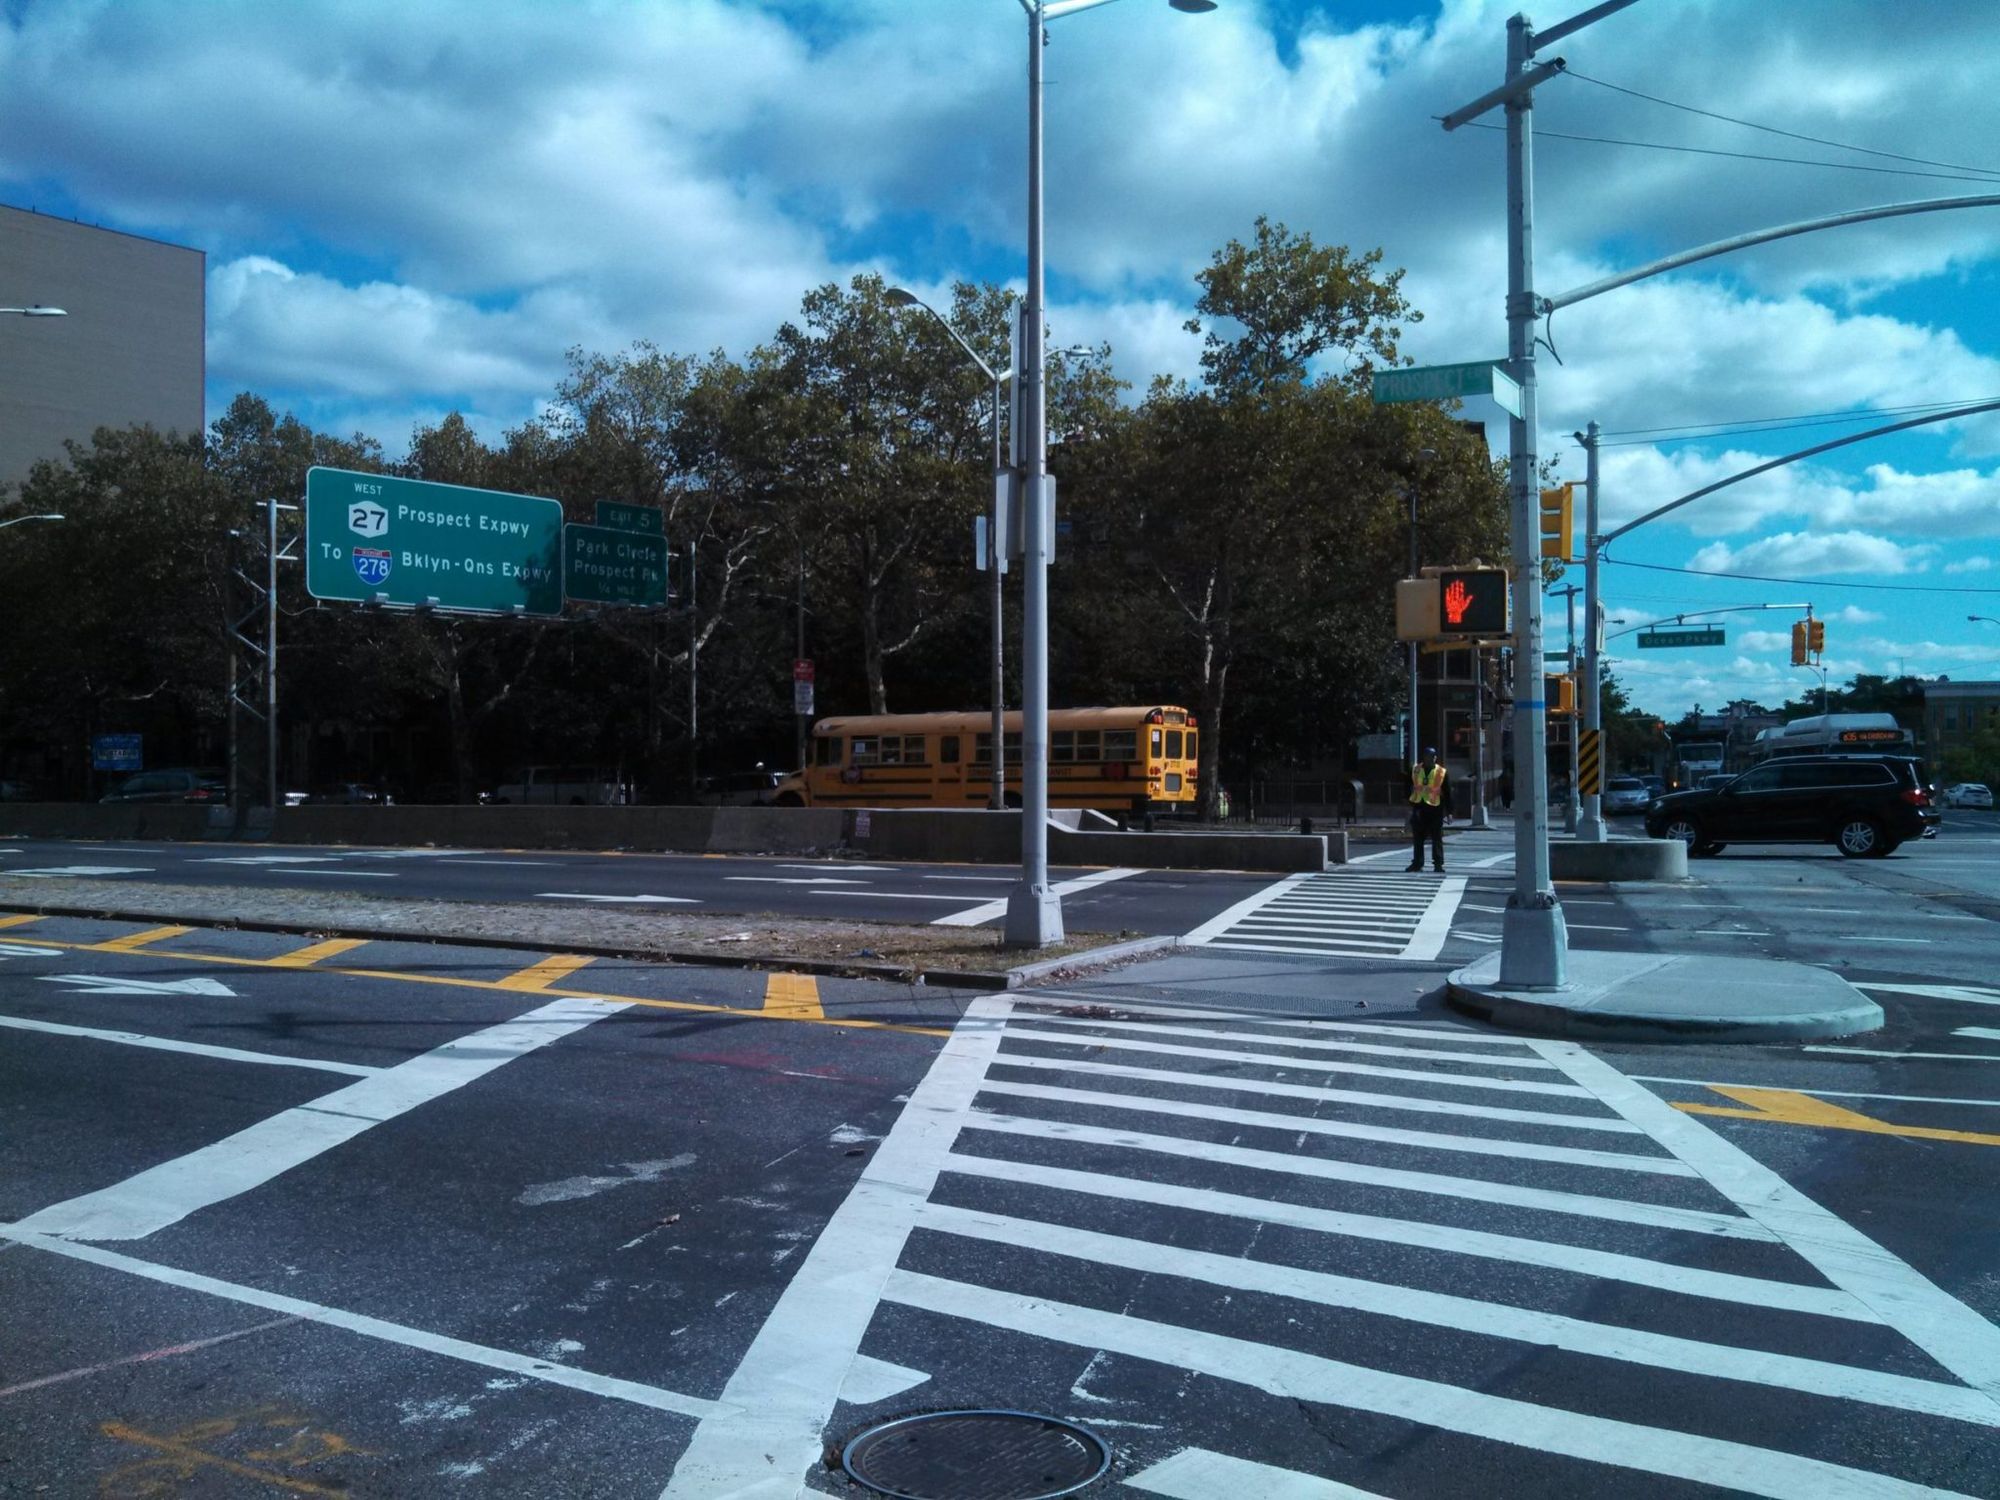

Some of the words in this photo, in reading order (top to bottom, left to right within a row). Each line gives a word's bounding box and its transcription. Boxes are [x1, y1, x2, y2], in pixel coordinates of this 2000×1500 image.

[1379, 368, 1464, 398] PROSPECT
[354, 483, 382, 495] WEST
[352, 508, 385, 530] 27
[398, 505, 471, 528] Prospect
[479, 515, 529, 538] Expwy
[576, 538, 609, 555] Park
[617, 543, 656, 561] Circle
[321, 543, 341, 559] To
[358, 557, 388, 576] 278
[502, 562, 551, 583] Expwy
[575, 559, 635, 579] Prospect
[1644, 635, 1682, 645] Ocean
